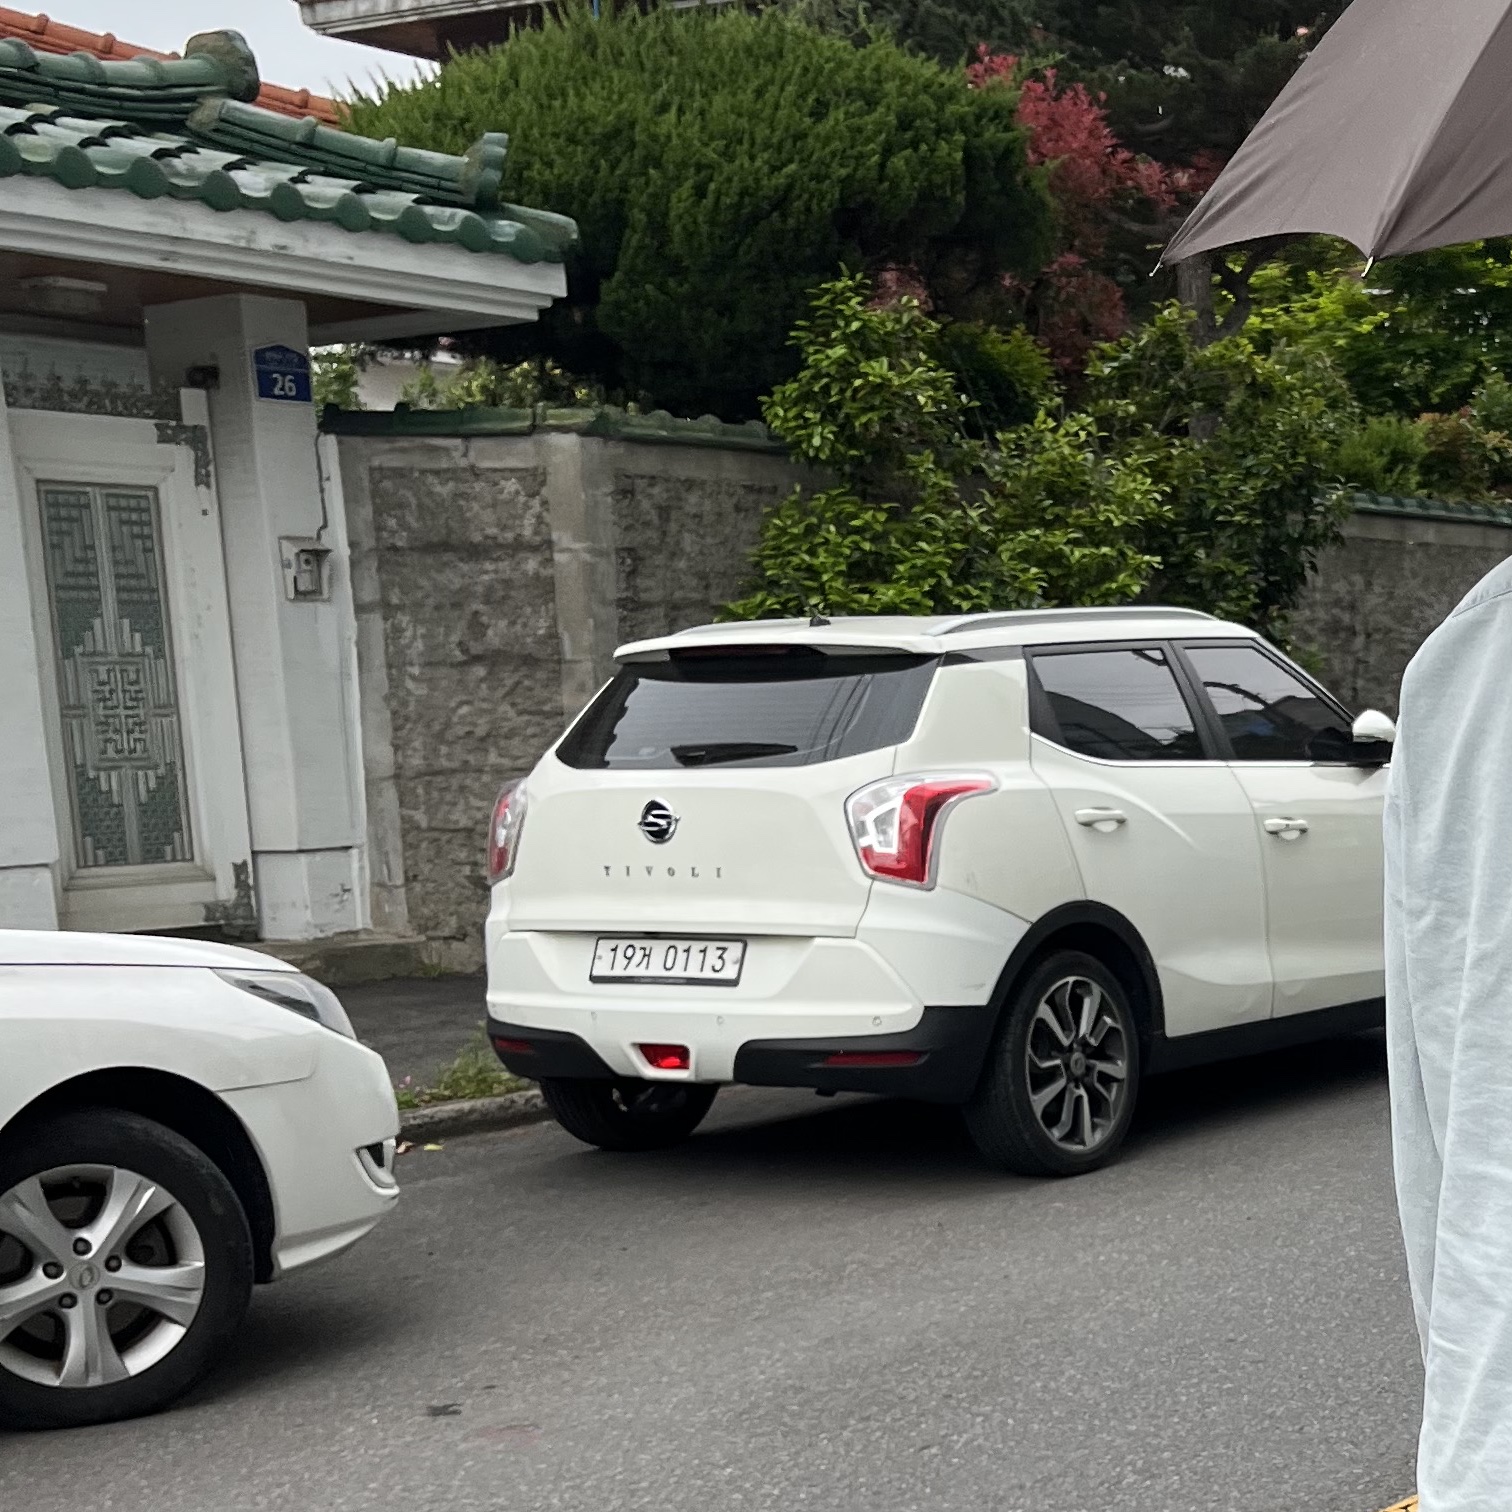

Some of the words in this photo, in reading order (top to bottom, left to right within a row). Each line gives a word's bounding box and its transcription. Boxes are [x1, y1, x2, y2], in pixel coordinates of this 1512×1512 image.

[272, 373, 297, 397] 26
[603, 865, 722, 879] TIVOLI
[610, 943, 653, 972] 19거
[663, 944, 729, 974] 0113
